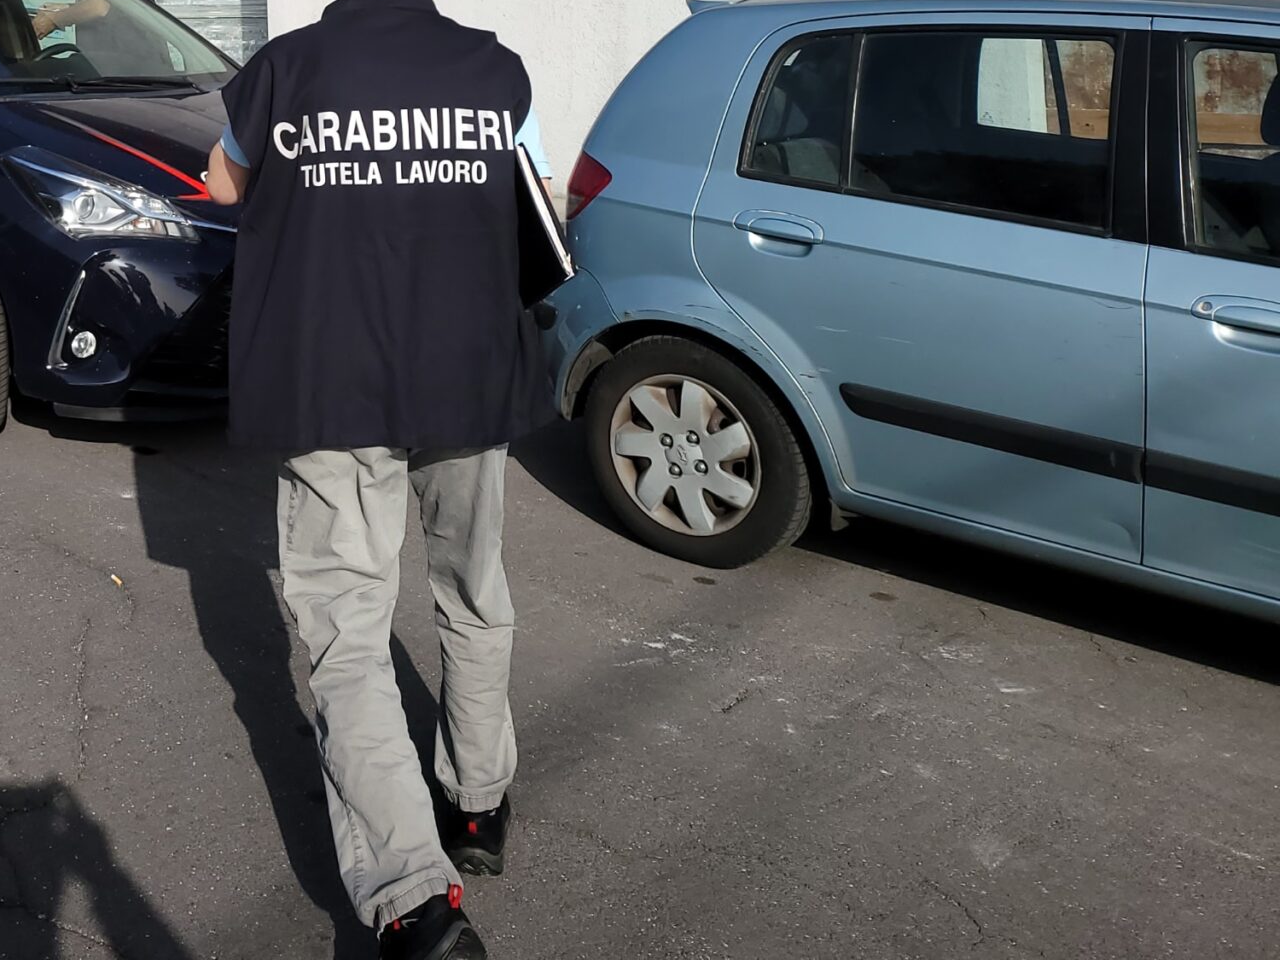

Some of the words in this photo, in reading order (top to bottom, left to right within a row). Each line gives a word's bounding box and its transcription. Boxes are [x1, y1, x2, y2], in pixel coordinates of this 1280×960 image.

[273, 107, 514, 159] CARABINIERI
[301, 161, 382, 187] TUTELA
[395, 160, 487, 184] LAVORO
